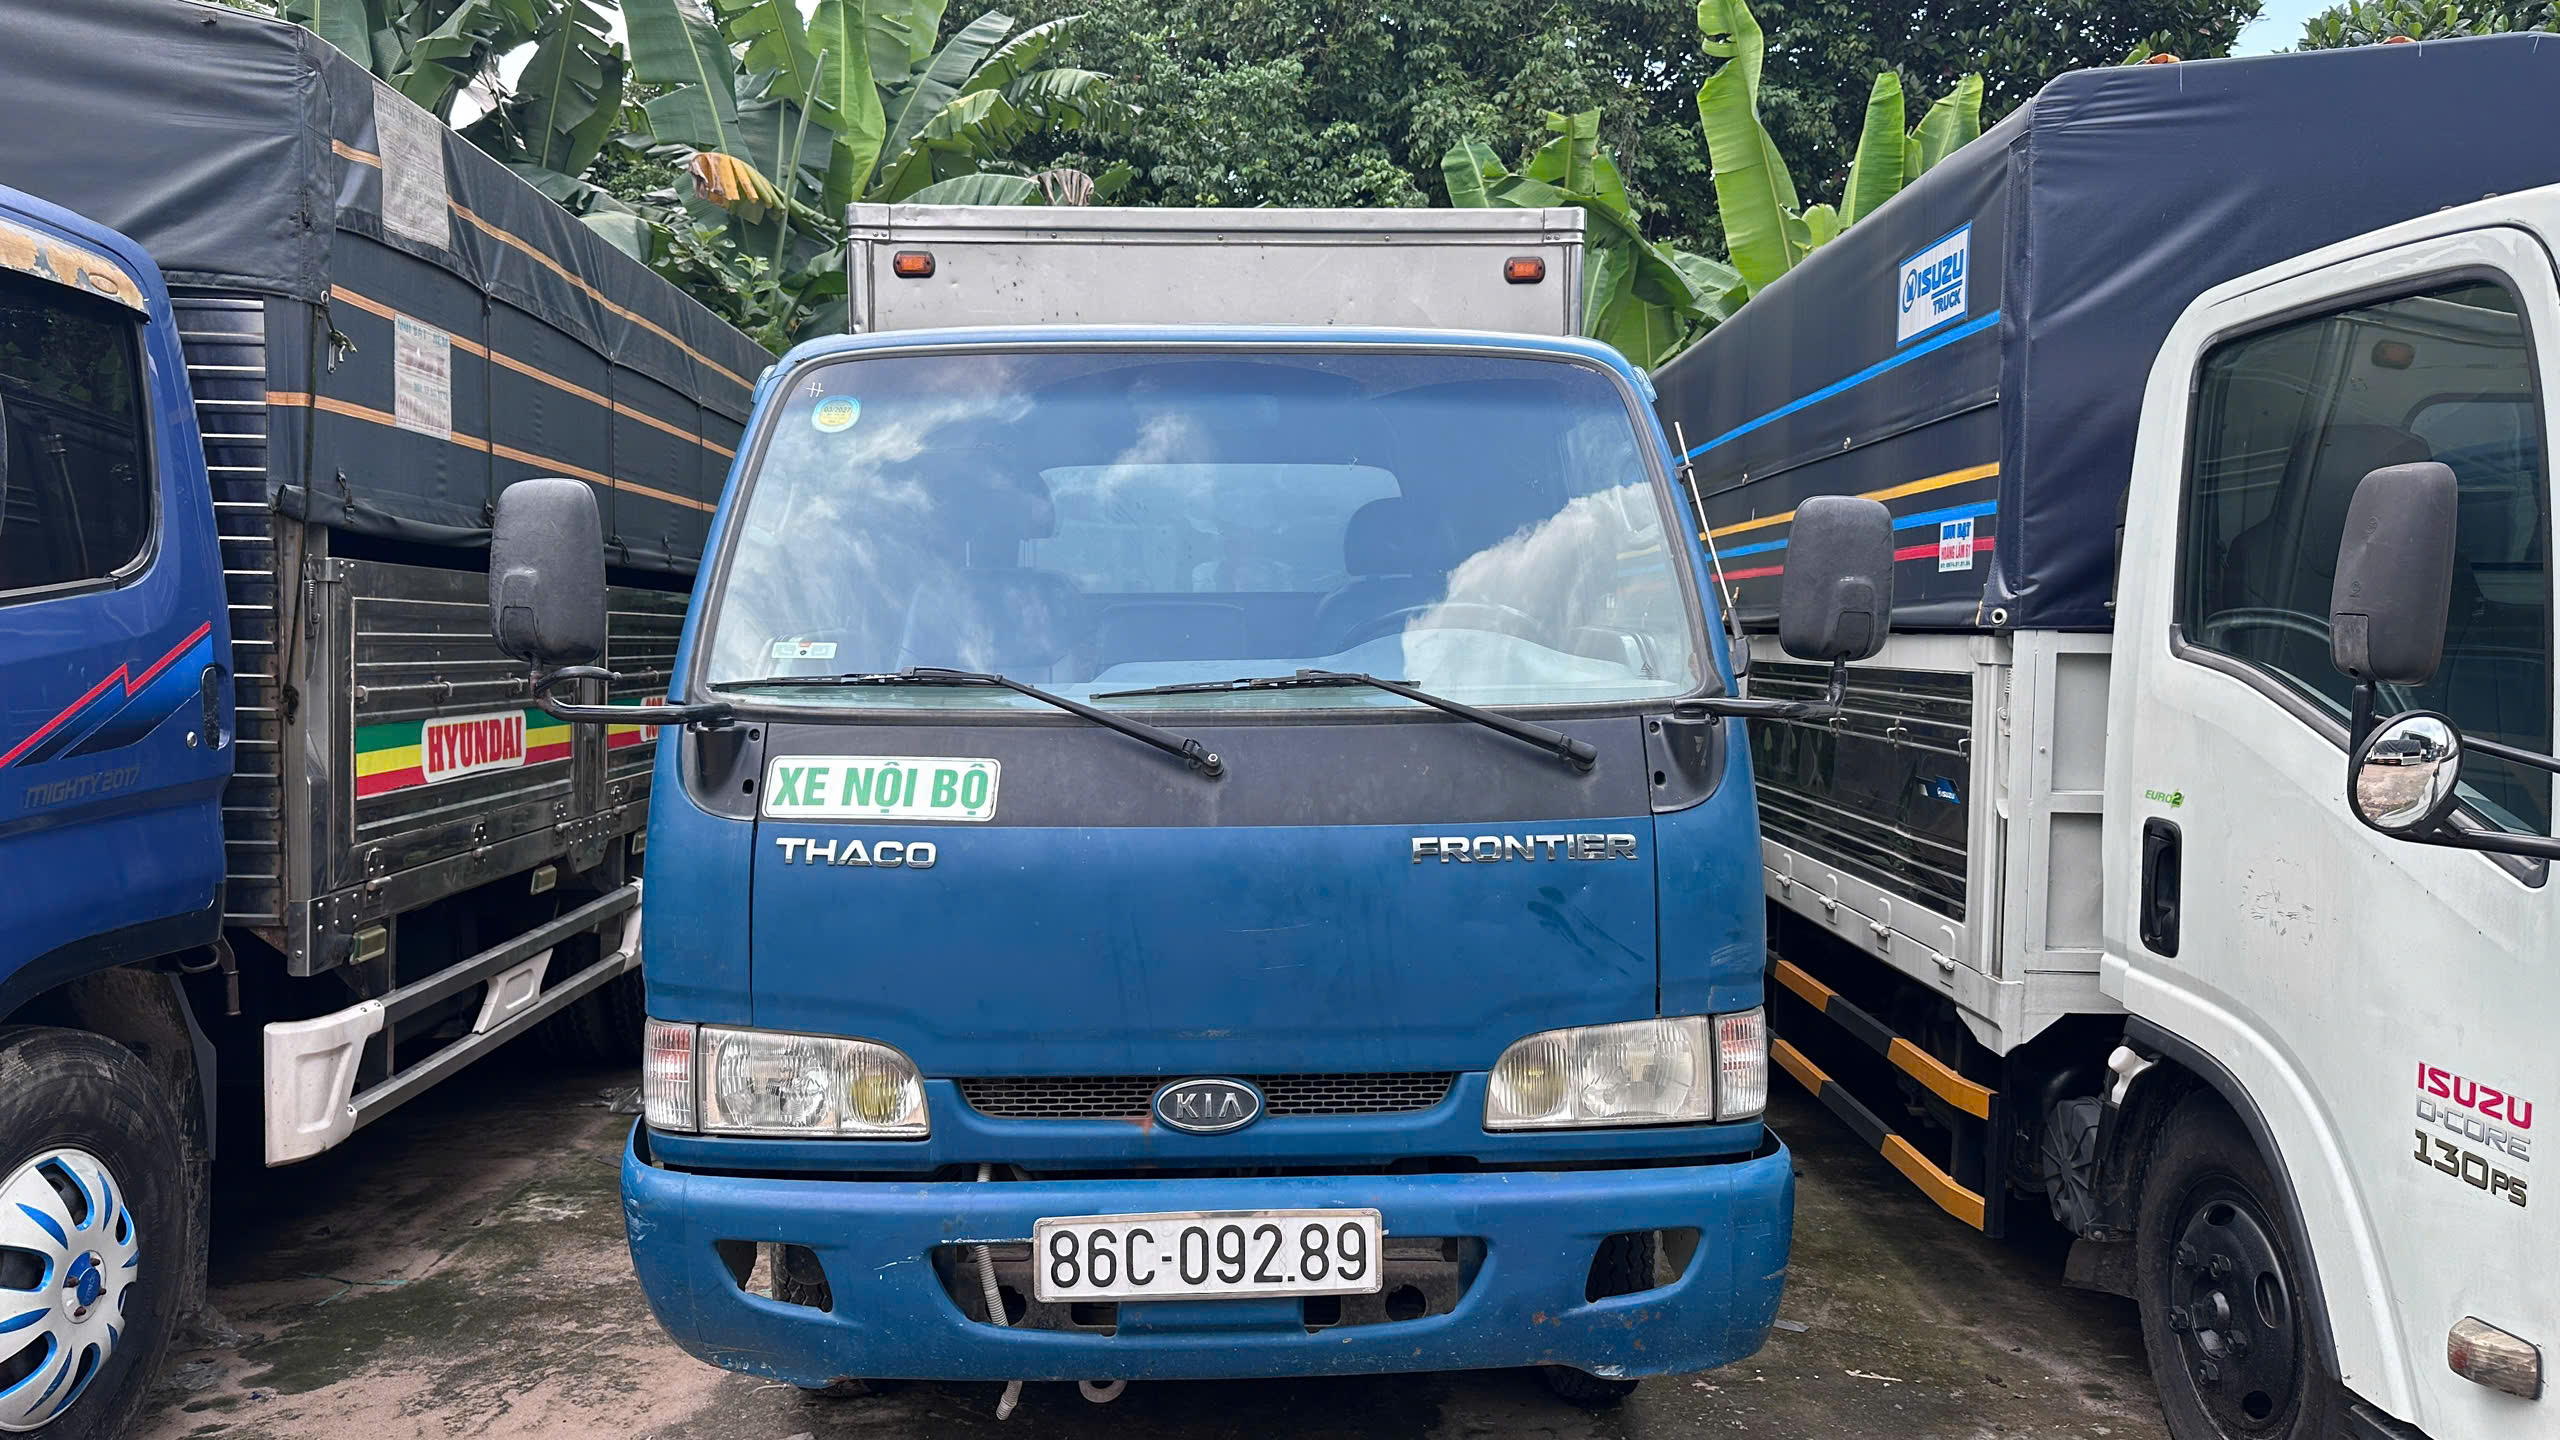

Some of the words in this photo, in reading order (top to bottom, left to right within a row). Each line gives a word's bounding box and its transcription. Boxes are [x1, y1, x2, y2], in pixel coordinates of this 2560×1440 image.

[1917, 248, 1965, 299] ISUZU
[1932, 287, 1962, 316] TRUCK
[427, 715, 522, 774] HYUNDAI
[23, 771, 103, 809] MIGHTY
[102, 764, 141, 793] 2017
[772, 767, 830, 806] XE
[841, 761, 918, 814] NỘI
[930, 763, 989, 816] BỘ
[775, 837, 937, 869] THACO
[1411, 833, 1639, 864] FRONTIER
[1175, 1092, 1243, 1120] KIA
[2417, 1061, 2533, 1130] ISUZU
[1049, 1221, 1368, 1289] 86C-092.89
